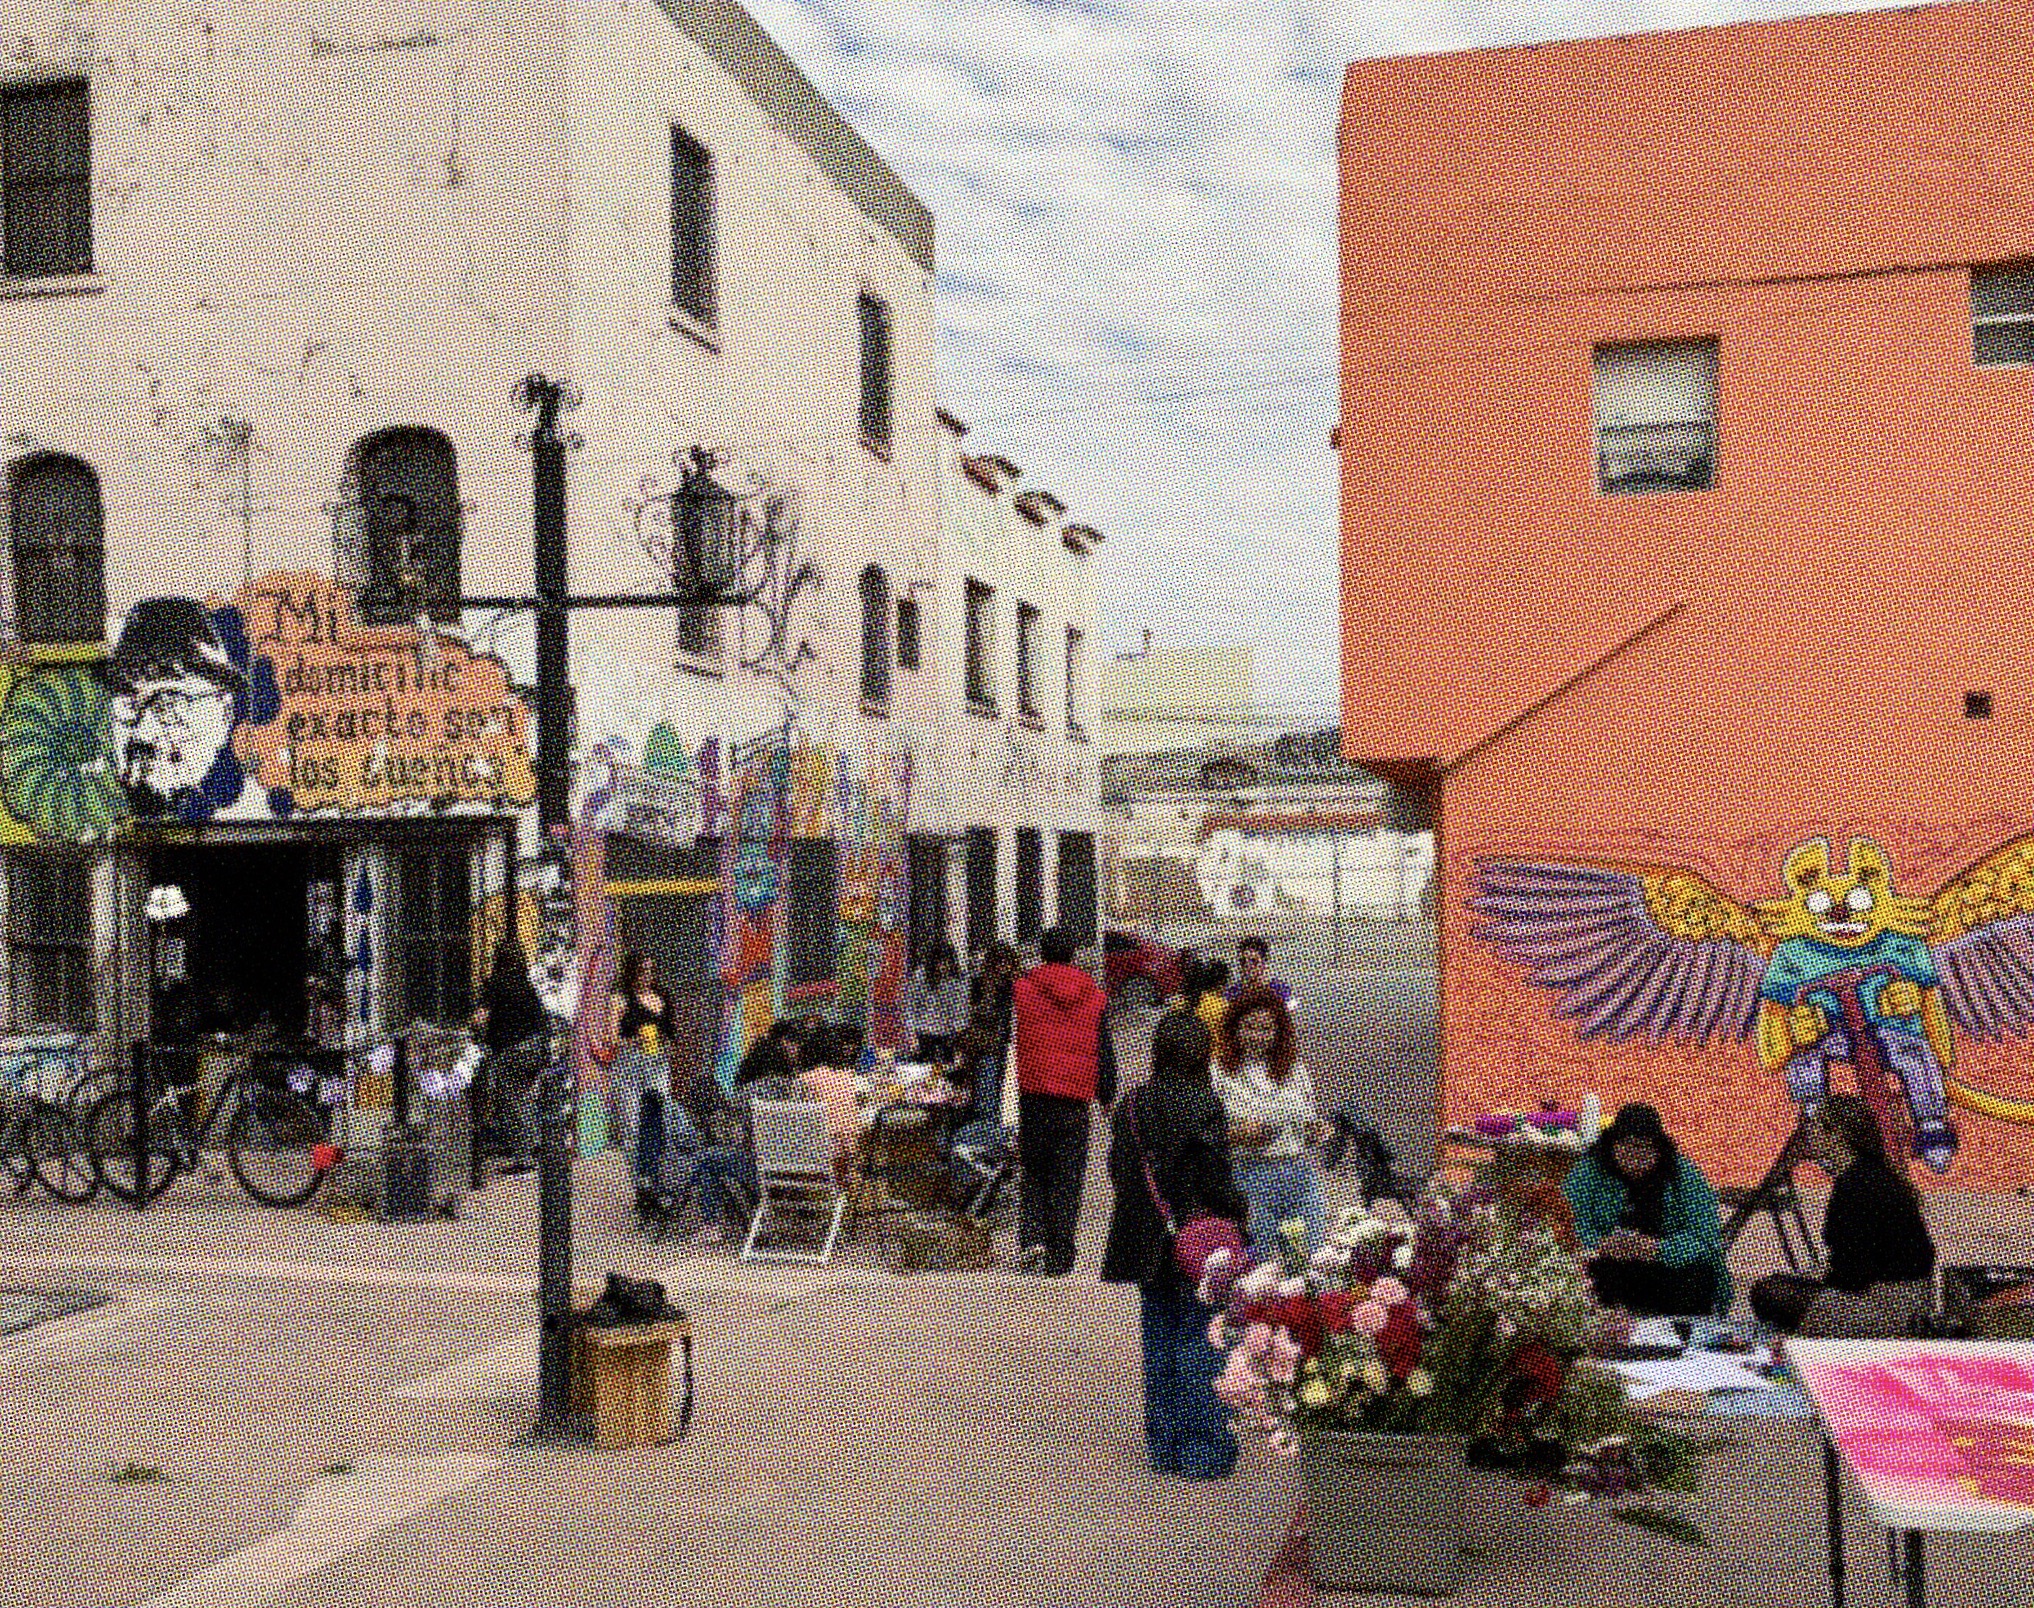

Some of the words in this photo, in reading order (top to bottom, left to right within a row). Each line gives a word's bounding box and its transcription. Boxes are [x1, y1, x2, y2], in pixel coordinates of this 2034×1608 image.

[256, 588, 339, 645] Mi
[287, 697, 428, 741] exacto
[288, 744, 340, 790] los
